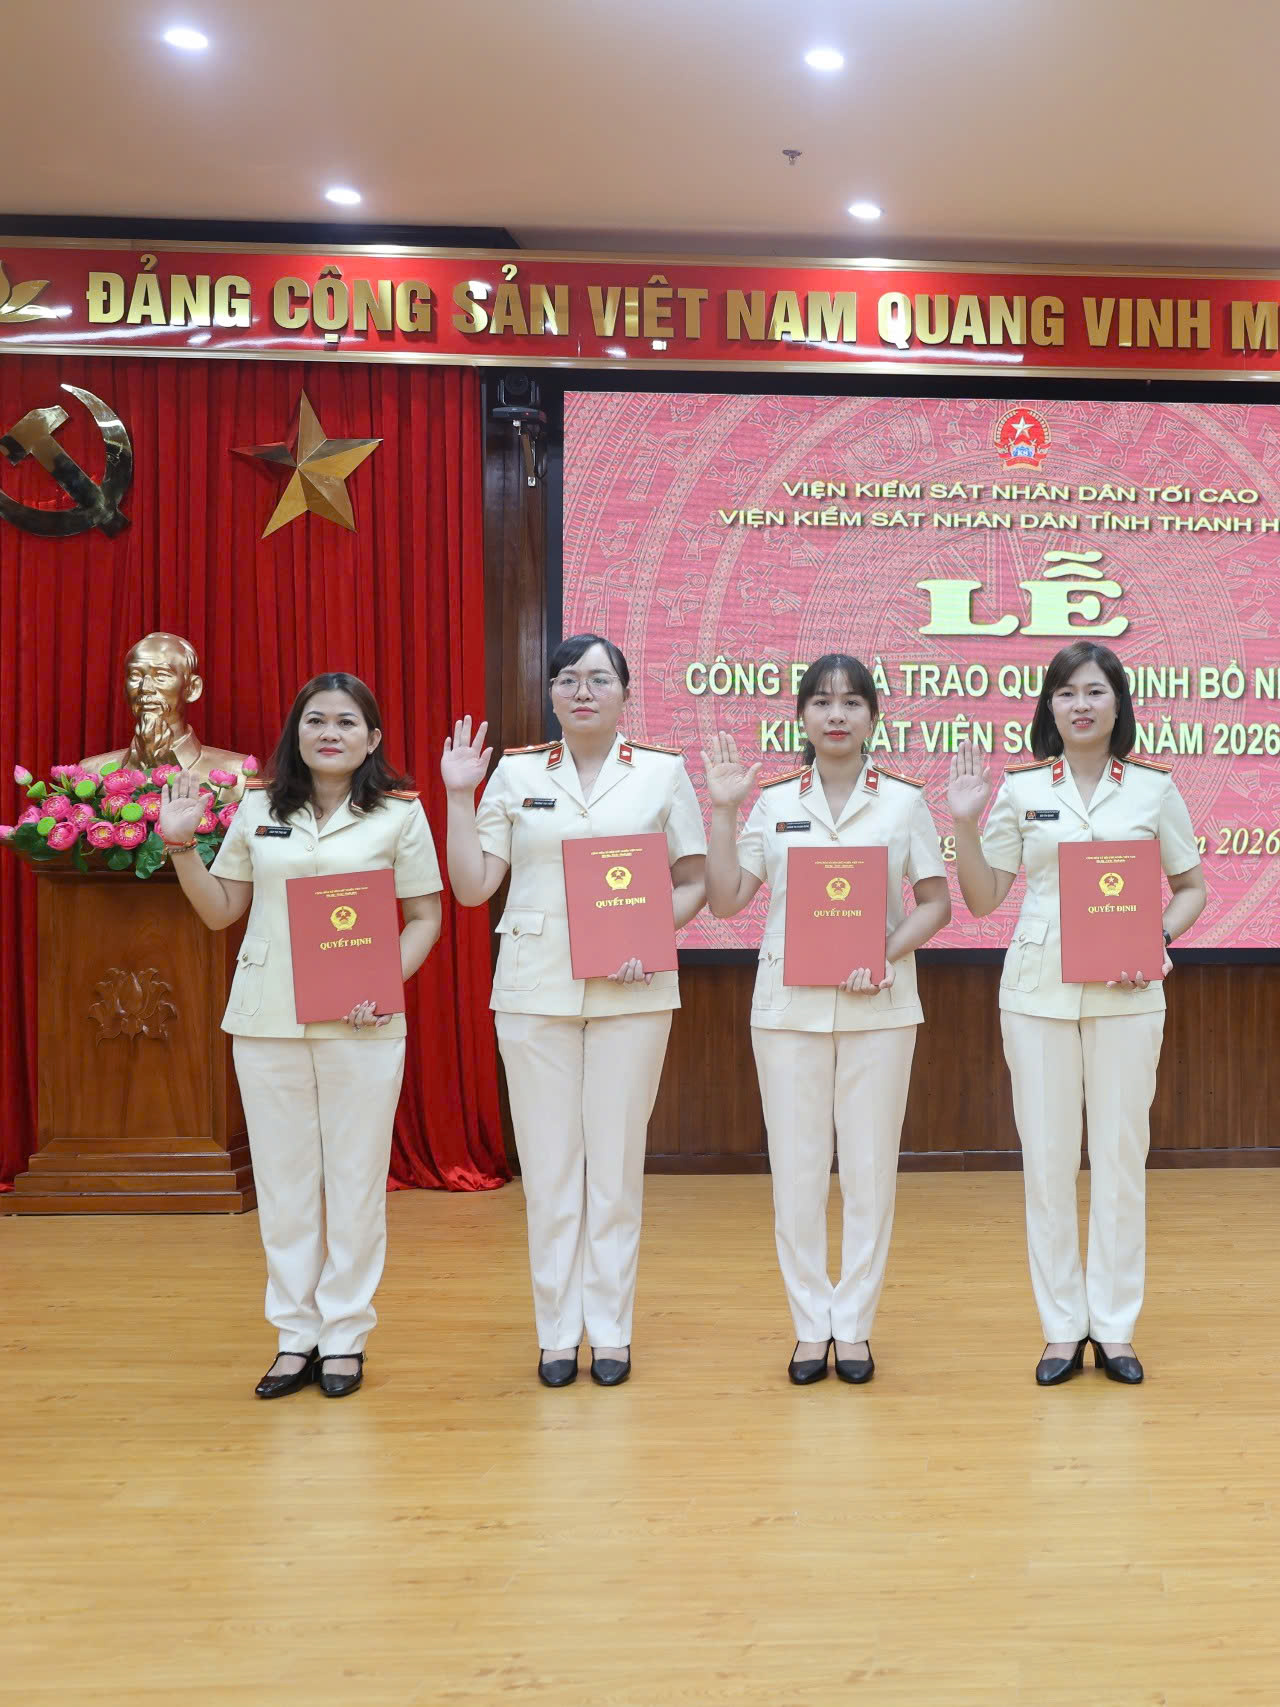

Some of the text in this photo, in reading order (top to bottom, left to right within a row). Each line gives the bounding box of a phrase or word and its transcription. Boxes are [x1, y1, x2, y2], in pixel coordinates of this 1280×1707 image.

[86, 254, 250, 328] ĐẢNG
[273, 264, 432, 343] CỘNG
[453, 263, 570, 336] SẢN
[588, 275, 707, 351] VIỆT
[726, 290, 858, 342] NAM
[877, 290, 1065, 351] QUANG
[1083, 294, 1210, 349] VINH
[782, 479, 1259, 504] VIỆN KIỂM SÁT NHÂN DÂN TỐI CAO
[719, 508, 785, 528] VIỆN
[794, 505, 862, 526] KIỂM
[871, 509, 925, 528] SÁT
[933, 511, 1011, 529] NHÂN
[1020, 512, 1078, 530] DÂN
[1158, 515, 1252, 533] THANH
[916, 550, 1129, 637] LỄ
[685, 656, 781, 696] CÔNG
[900, 664, 989, 697] TRAO
[1201, 659, 1246, 700] BỔ
[865, 712, 911, 753] ÁT
[921, 715, 993, 753] VIÊN
[1135, 716, 1203, 755] NĂM
[813, 908, 840, 918] QUYẾT
[1088, 903, 1115, 914] QUYẾT
[320, 938, 349, 951] QUYẾT
